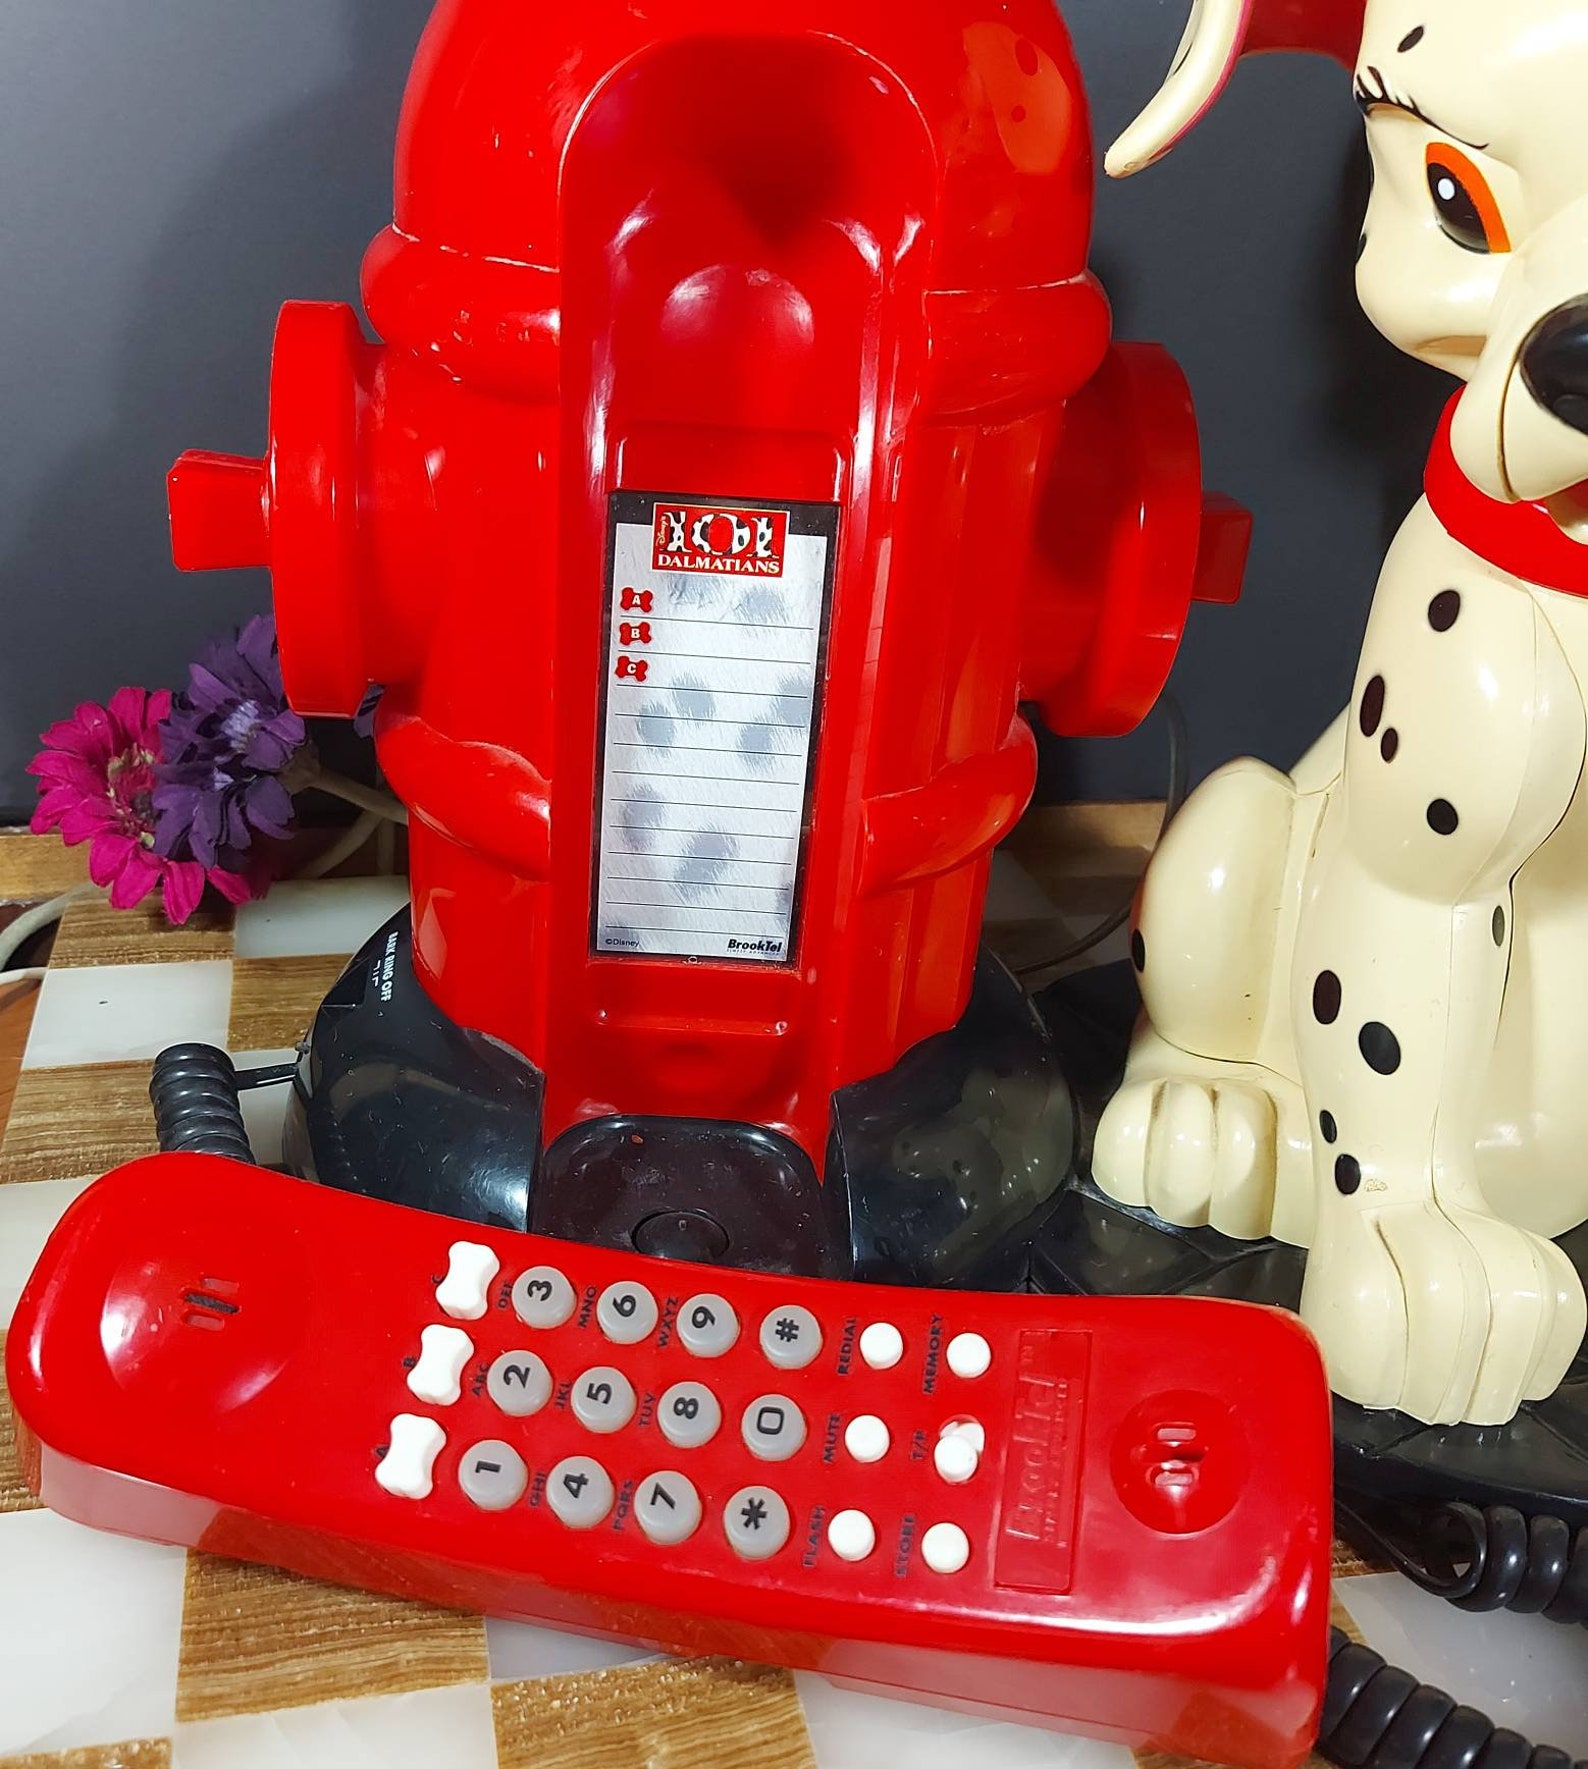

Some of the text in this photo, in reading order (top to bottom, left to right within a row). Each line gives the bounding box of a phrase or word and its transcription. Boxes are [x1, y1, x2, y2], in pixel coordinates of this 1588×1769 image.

[665, 511, 780, 559] 101
[658, 554, 780, 574] DALMATIANS
[631, 594, 641, 606] A
[630, 627, 640, 639] B
[626, 662, 637, 674] C
[728, 938, 783, 953] BrookTel
[382, 954, 396, 980] RING
[381, 981, 392, 1001] OFF
[528, 1280, 552, 1301] 3
[578, 1286, 597, 1328] MNO
[612, 1295, 637, 1317] 6
[692, 1306, 715, 1328] 9
[657, 1297, 678, 1347] WXYZ
[775, 1317, 800, 1342] #
[837, 1318, 856, 1375] REDIAL
[924, 1314, 942, 1394] MEMORY
[473, 1364, 489, 1396] ABC
[504, 1364, 530, 1388] 2
[554, 1382, 571, 1409] JKL
[587, 1383, 612, 1404] 5
[640, 1394, 656, 1426] TUV
[674, 1397, 699, 1420] 8
[756, 1406, 784, 1435] 0
[824, 1414, 841, 1463] MUTE
[912, 1430, 926, 1460] T/P
[475, 1461, 501, 1474] 1
[530, 1472, 546, 1506] GHI
[563, 1473, 589, 1499] 4
[651, 1483, 676, 1509] 7
[804, 1506, 825, 1566] FLASH
